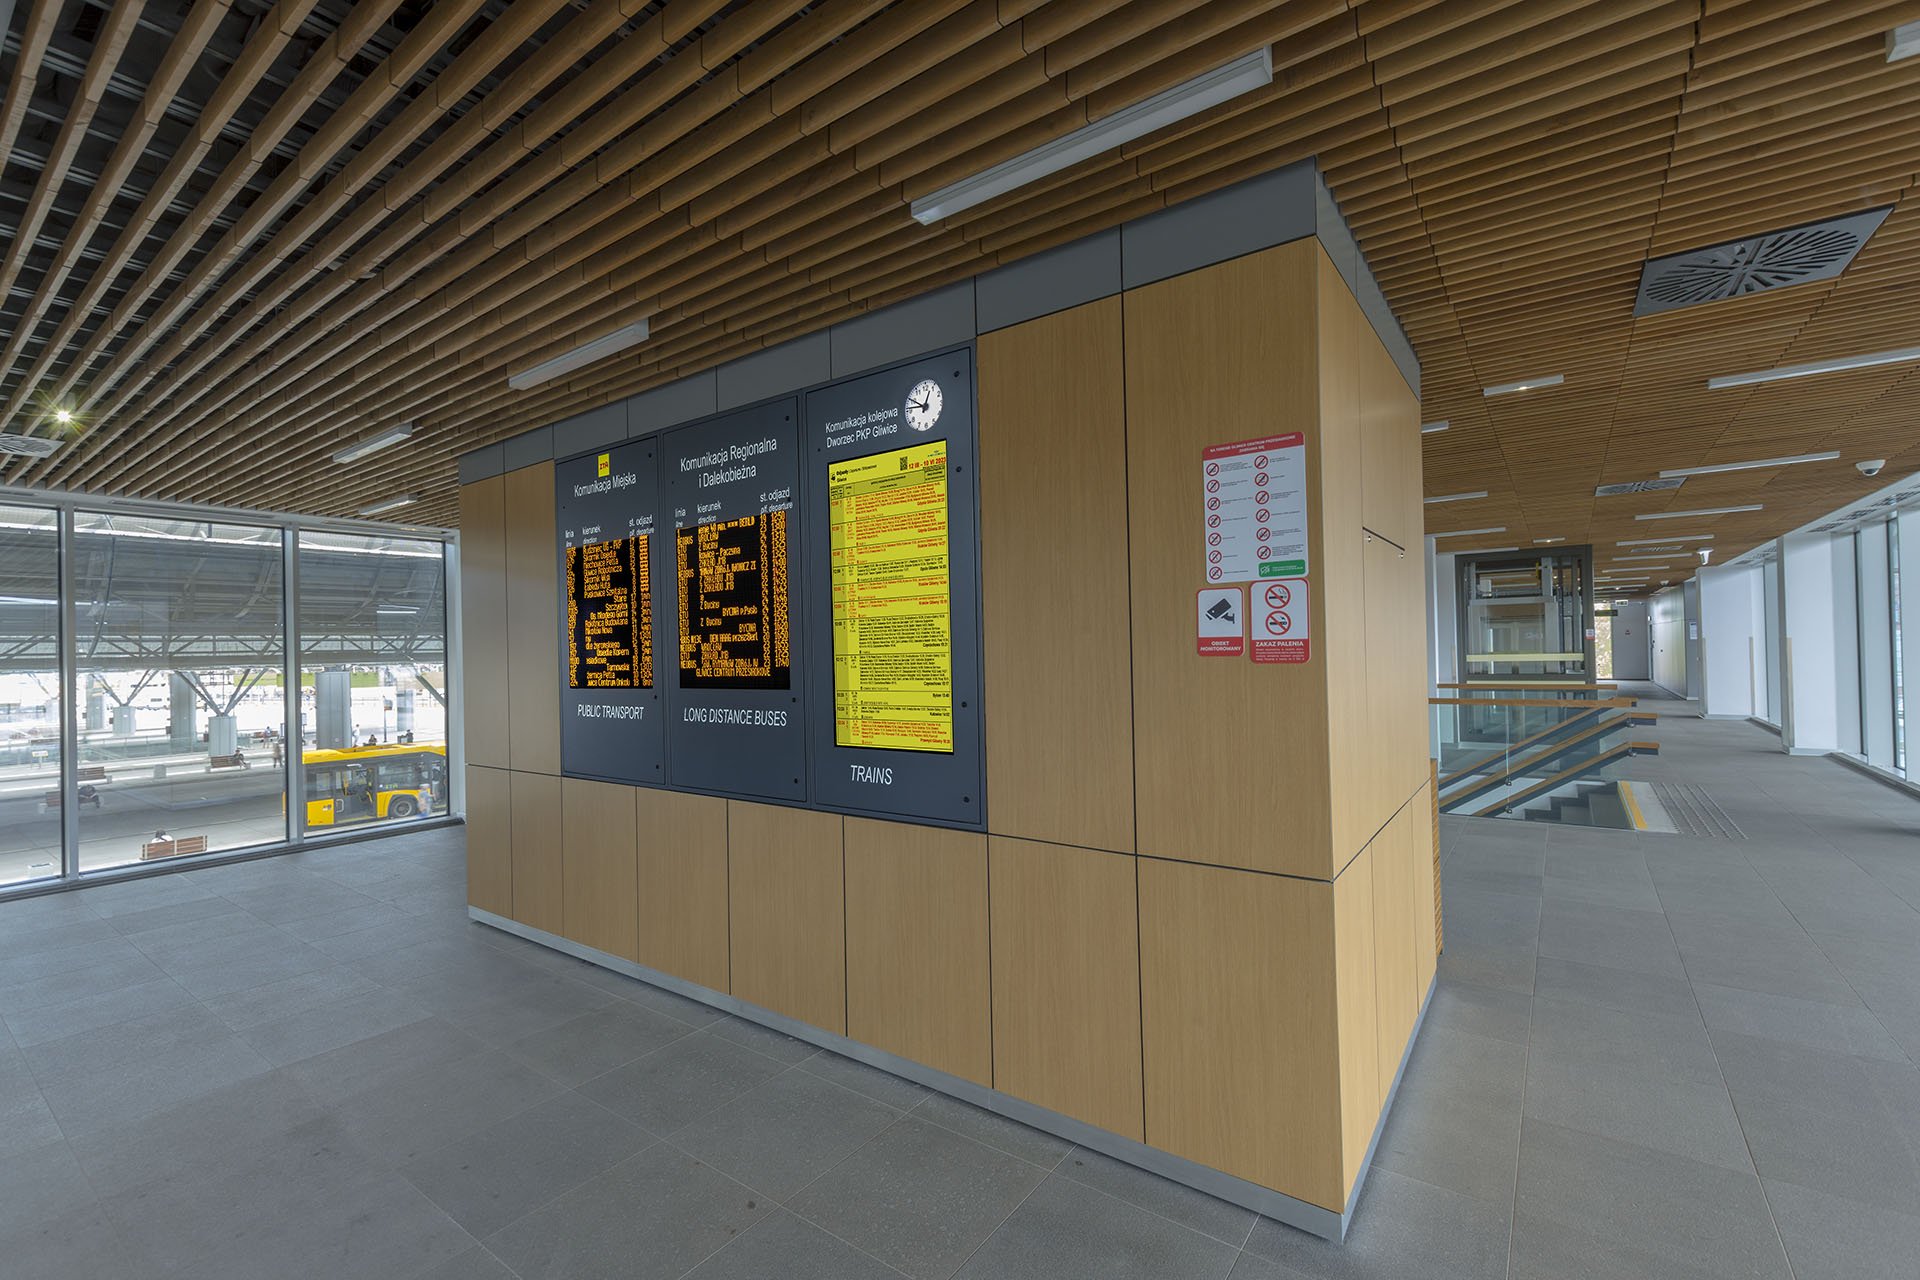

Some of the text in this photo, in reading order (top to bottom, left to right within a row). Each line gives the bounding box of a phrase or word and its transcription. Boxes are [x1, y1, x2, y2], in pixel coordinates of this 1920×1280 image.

[826, 408, 898, 433] Komunikacja kolejowa
[826, 422, 898, 448] Dworzec PKP Gliwice
[680, 438, 778, 472] Komunikacja Regionalna
[574, 472, 637, 498] Komunikacja Miejska
[703, 464, 756, 488] Dalekobieżna
[768, 487, 790, 502] odjazd
[674, 501, 722, 518] linia kierunek
[769, 502, 793, 512] departure
[636, 514, 653, 526] odjazd
[577, 704, 644, 720] PUBLIC TRANSPORT
[684, 708, 787, 726] LONG DISTANCE BUSES
[850, 765, 893, 785] TRAINS
